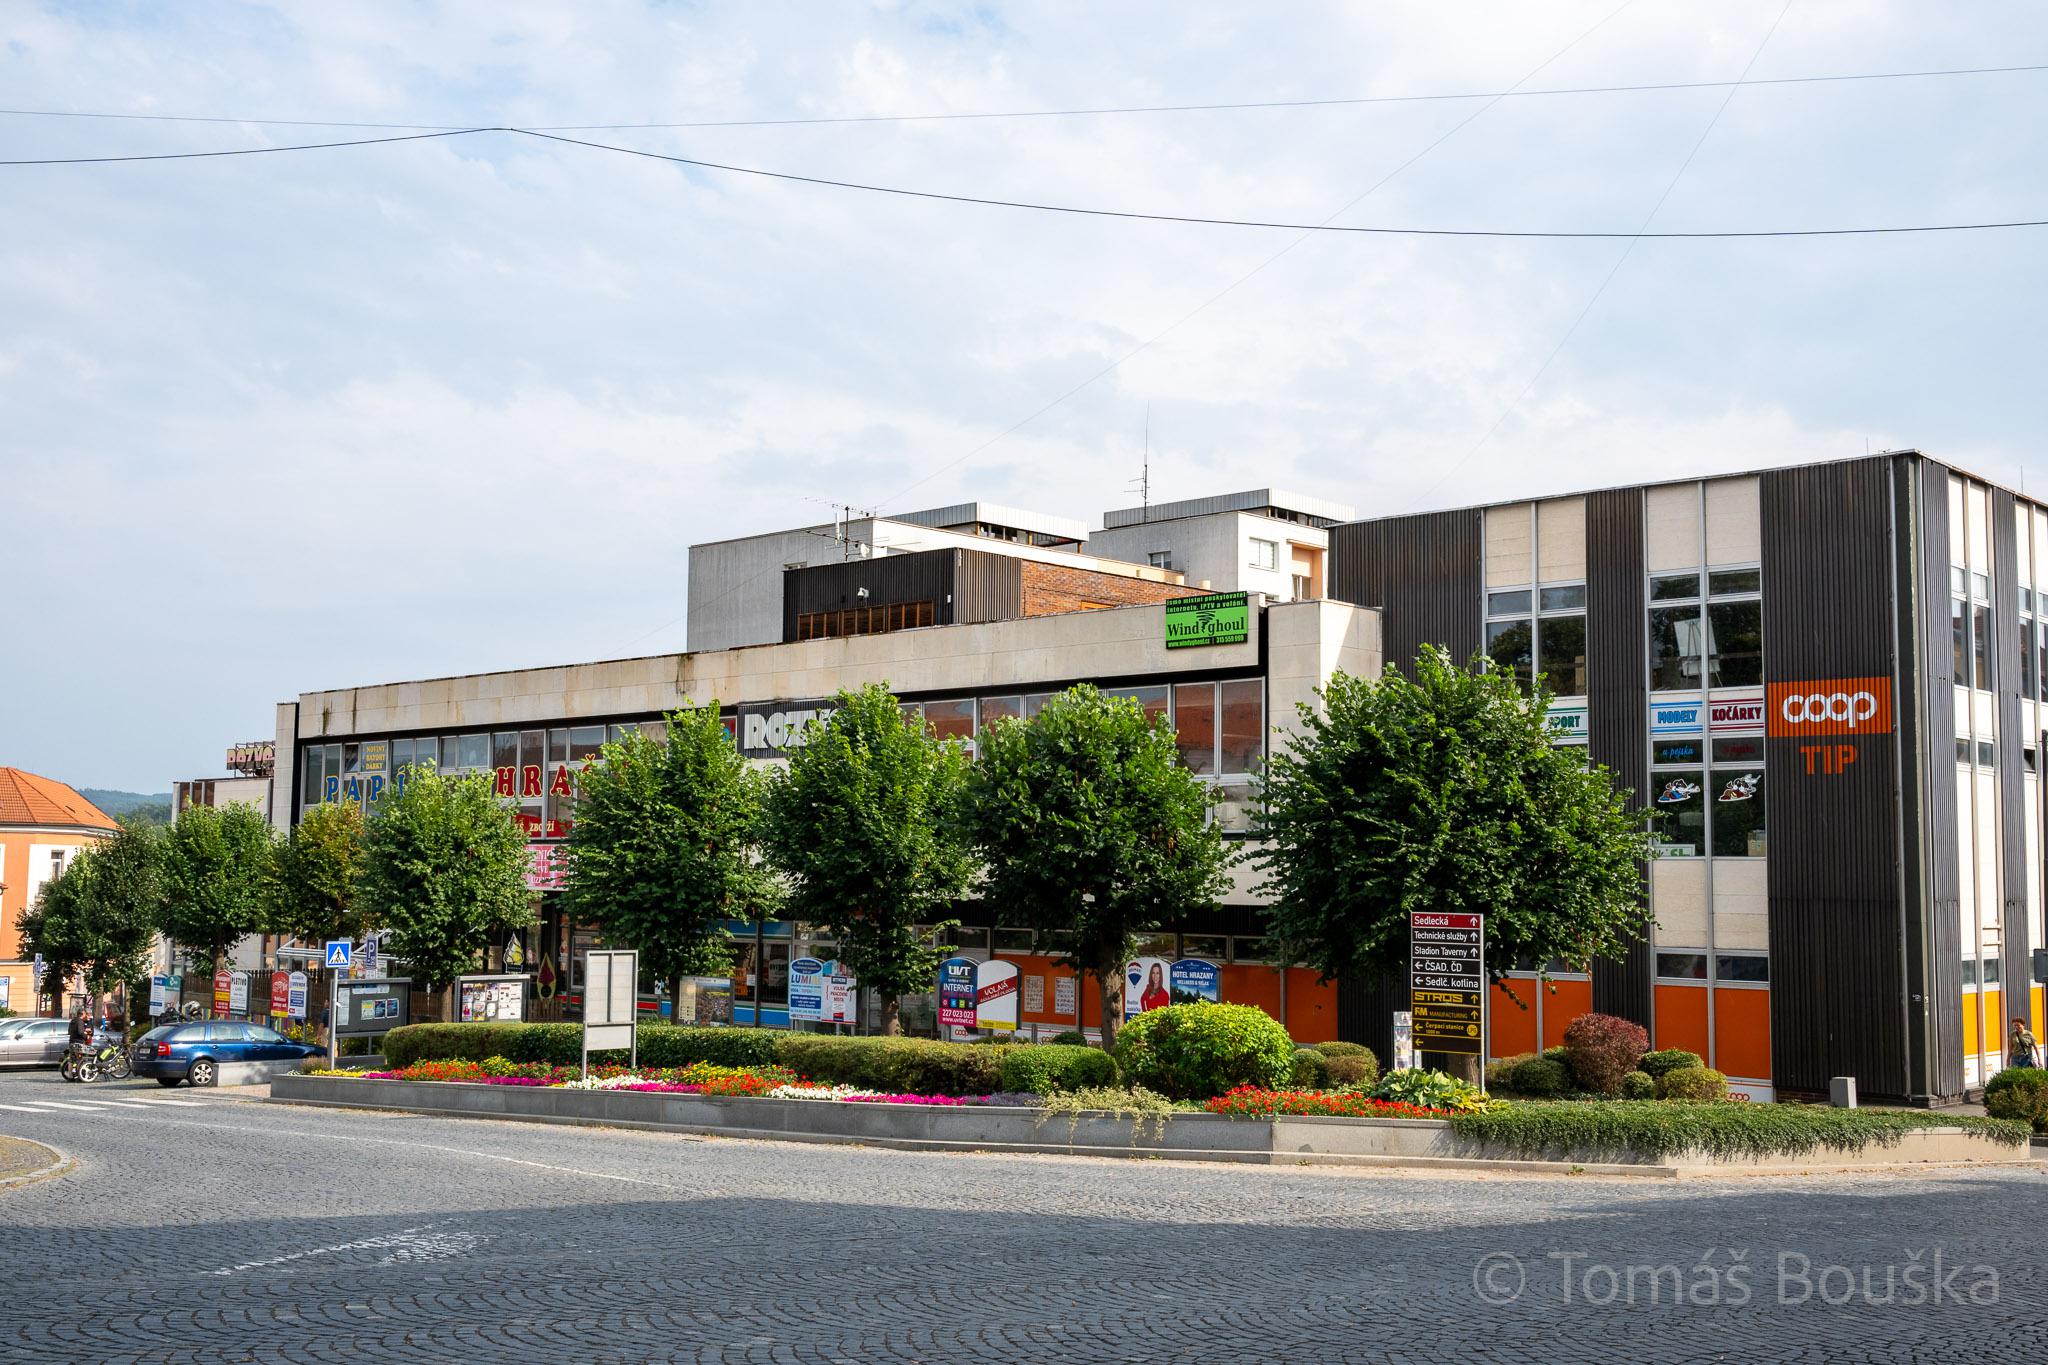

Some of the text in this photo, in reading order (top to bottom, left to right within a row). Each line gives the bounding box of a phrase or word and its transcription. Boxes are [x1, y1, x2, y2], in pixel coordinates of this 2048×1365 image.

[1712, 706, 1762, 721] KOČÁRKY
[1783, 691, 1877, 728] coop
[1658, 710, 1697, 723] MODELY
[1800, 745, 1857, 775] TIP
[1414, 916, 1449, 926] Sedlecká
[1414, 930, 1468, 942] Technické služby
[1414, 946, 1468, 958] Stadion Taverny
[1451, 961, 1463, 972] ČD
[1189, 971, 1214, 980] HRAZANY
[1425, 977, 1479, 988] Sedlč. kotlina
[943, 984, 974, 993] INTERNET
[1414, 992, 1463, 1003] STROS
[952, 1010, 963, 1018] 023
[963, 1011, 974, 1019] 023
[1414, 1007, 1428, 1016] FM
[1446, 1023, 1464, 1031] stanice
